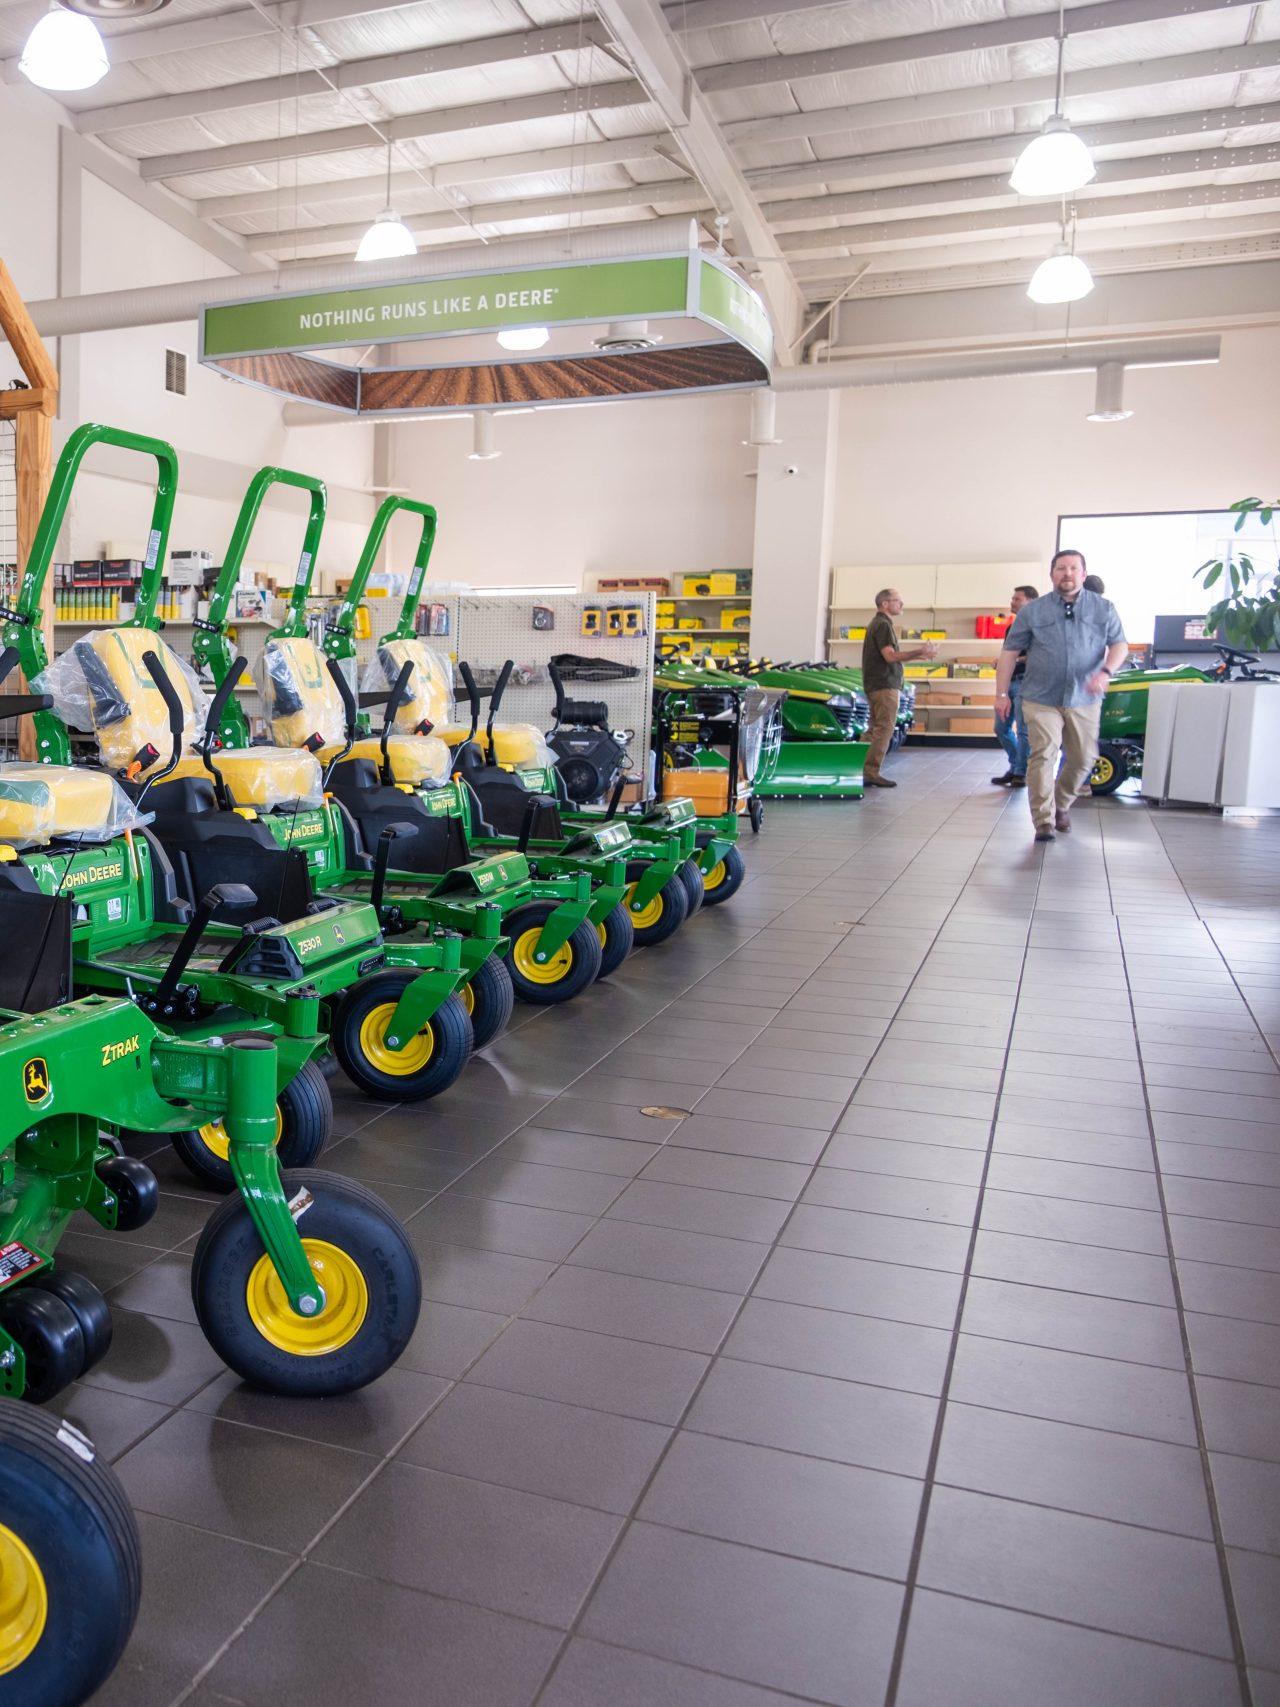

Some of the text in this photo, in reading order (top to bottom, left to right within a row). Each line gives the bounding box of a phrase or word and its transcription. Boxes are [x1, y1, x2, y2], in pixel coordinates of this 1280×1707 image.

[300, 306, 376, 329] NOTHING
[381, 300, 428, 321] RUNS
[433, 296, 472, 315] LIKE
[476, 294, 489, 311] A
[284, 823, 324, 841] JOHN DEERE
[60, 863, 122, 890] JOHN DEERE
[101, 1033, 140, 1067] ZTRAK
